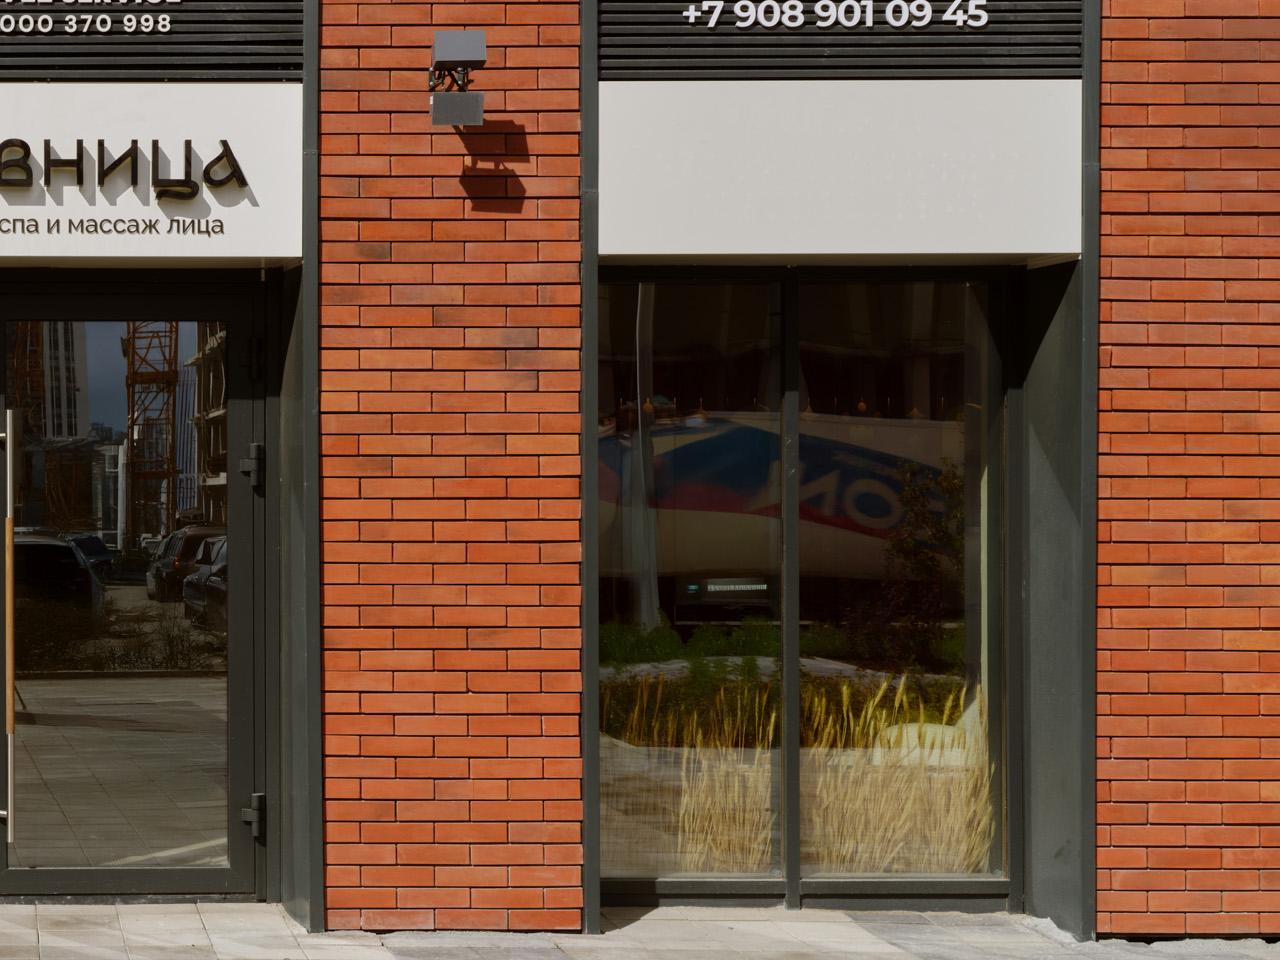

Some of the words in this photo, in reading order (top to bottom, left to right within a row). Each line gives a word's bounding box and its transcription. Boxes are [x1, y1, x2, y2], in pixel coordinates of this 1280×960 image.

[64, 14, 112, 33] 370
[123, 13, 171, 33] 998
[682, 0, 725, 28] +7
[733, 0, 805, 28] 908
[813, 0, 874, 27] 901
[885, 0, 933, 27] 09
[941, 0, 989, 27] 45
[47, 218, 60, 235] и
[68, 218, 160, 235] массаж
[167, 218, 225, 239] лица
